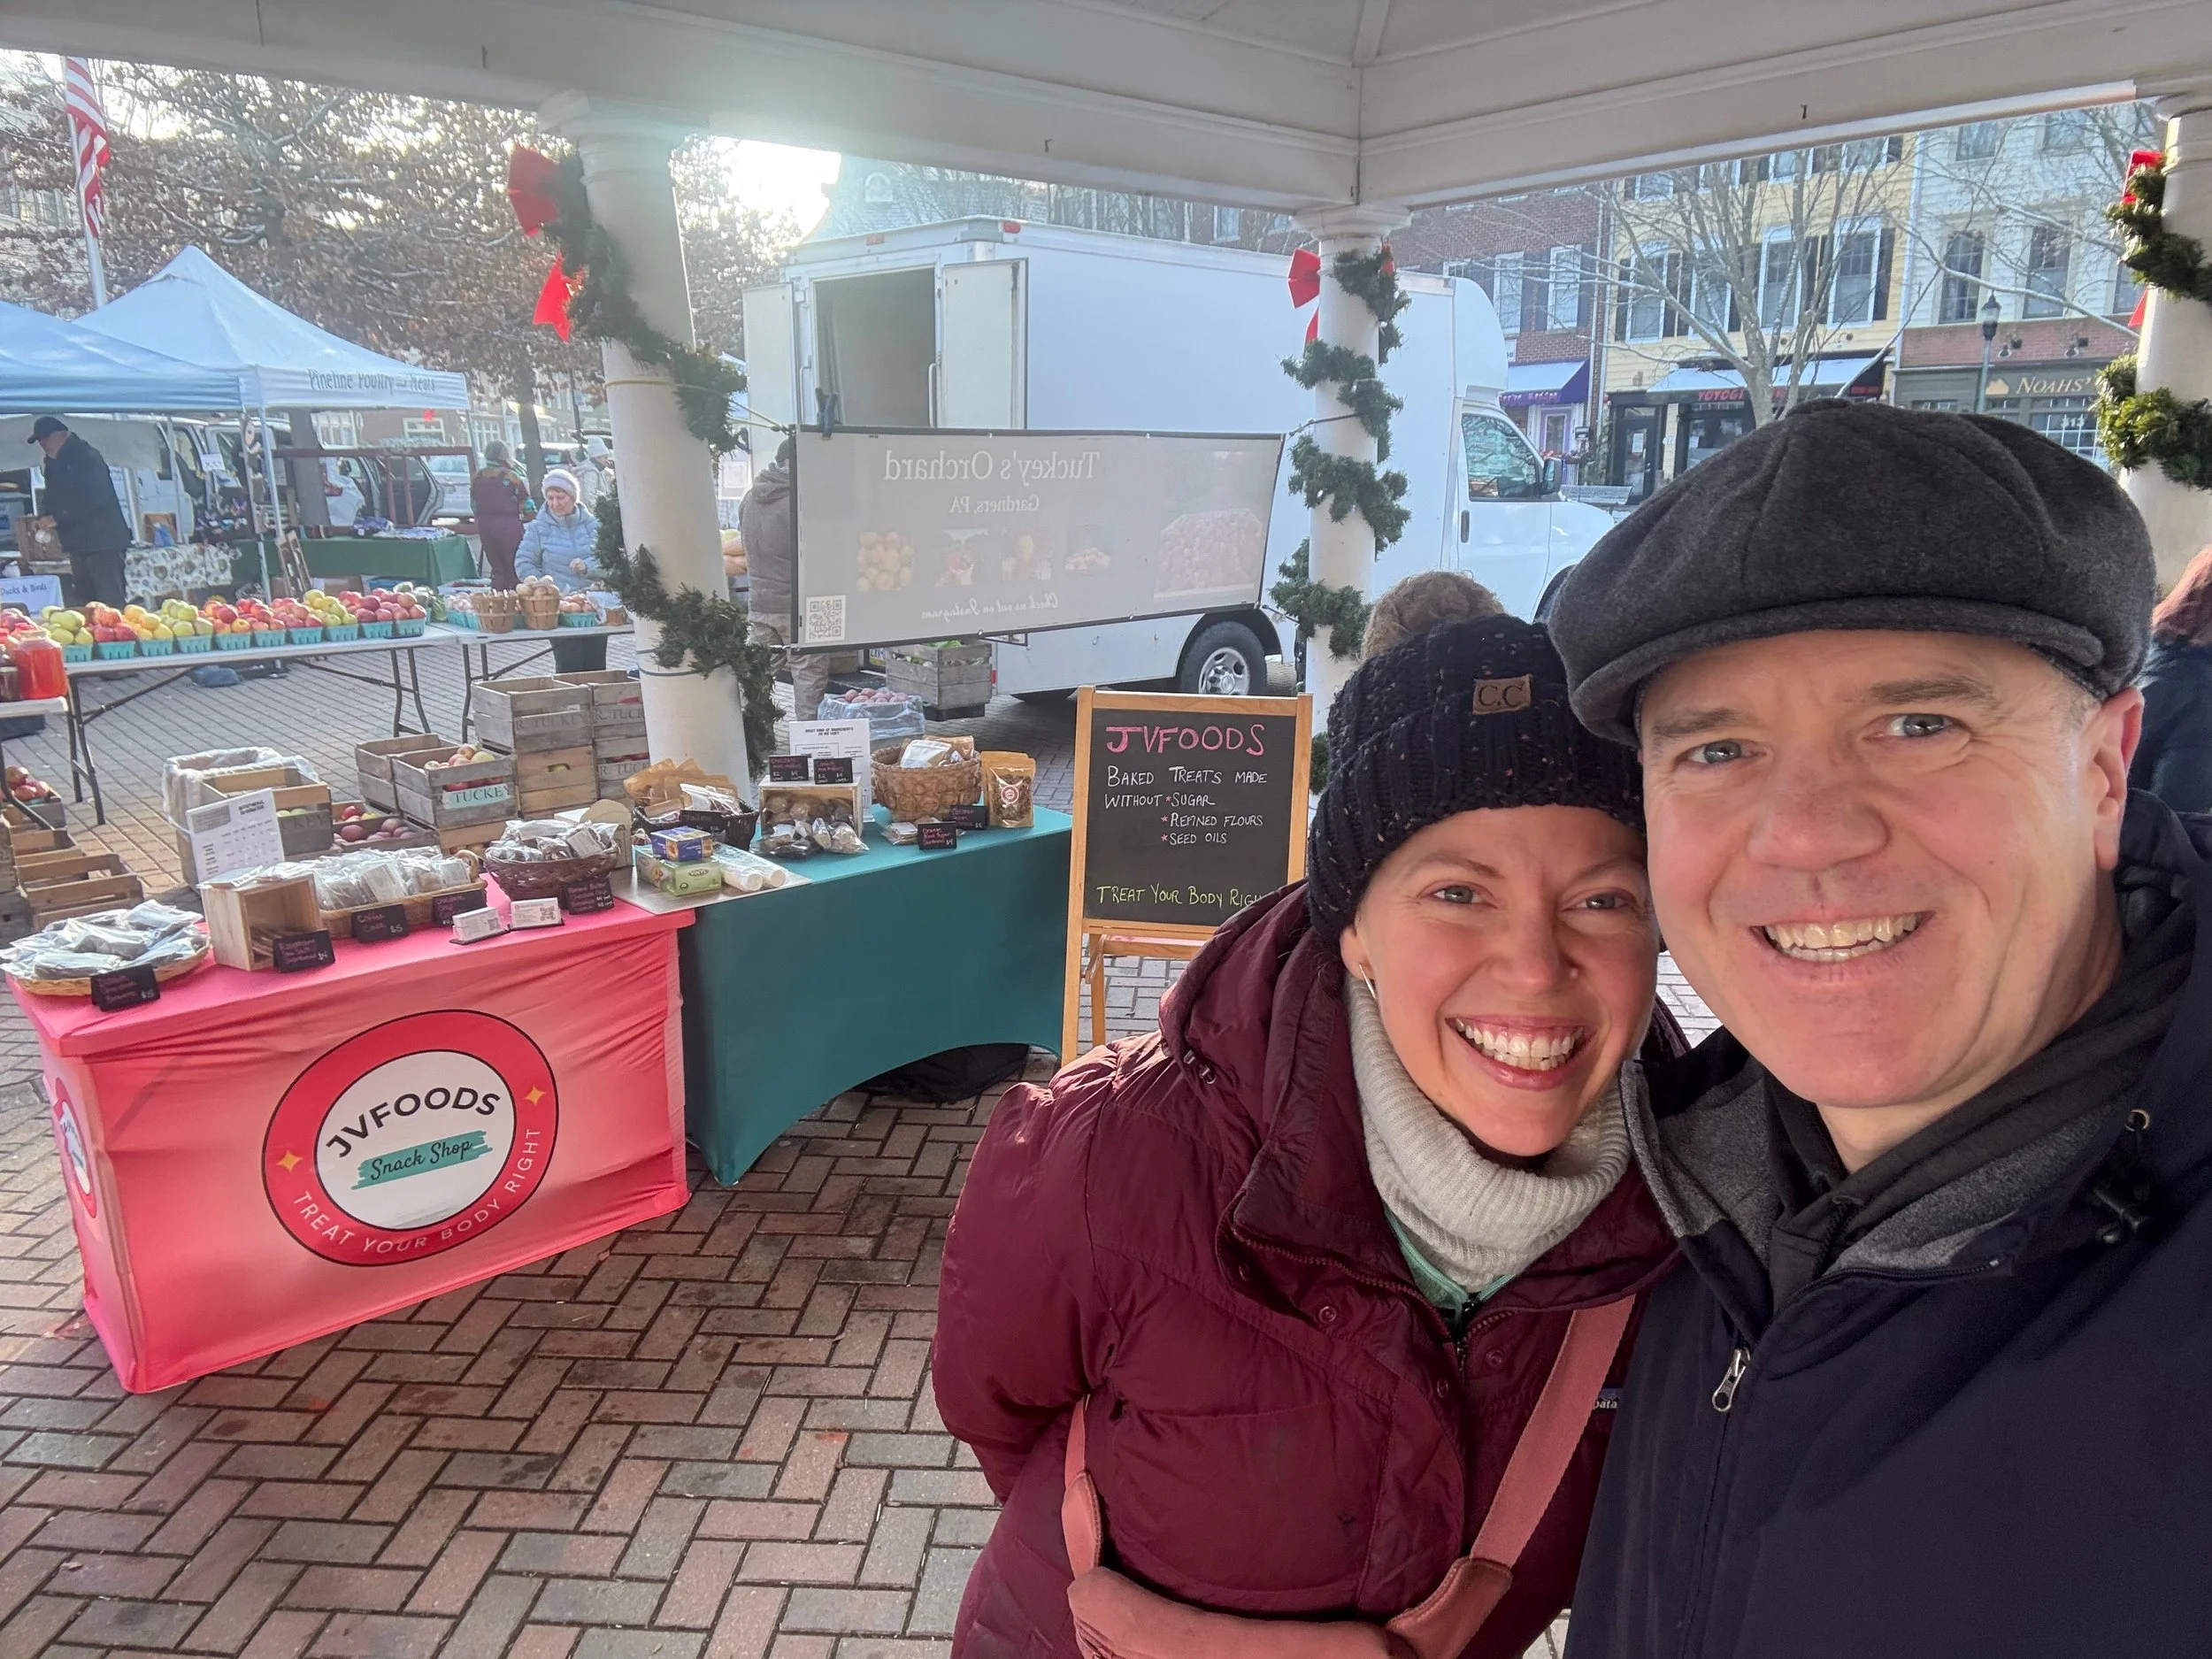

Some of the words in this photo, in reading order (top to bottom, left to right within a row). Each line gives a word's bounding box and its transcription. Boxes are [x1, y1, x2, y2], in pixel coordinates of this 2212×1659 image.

[357, 372, 394, 396] Poultry
[410, 373, 435, 392] Meats
[1698, 388, 1745, 402] YOYOGI
[612, 709, 644, 719] TUCK
[1106, 724, 1265, 756] JVFOODS
[616, 761, 650, 775] TUC
[1107, 765, 1155, 787] BAKED
[1169, 766, 1223, 785] TREATS
[1234, 771, 1268, 784] MADE
[1104, 794, 1164, 809] WITHOUT
[1171, 793, 1216, 807] SUGAR
[280, 815, 328, 831] CKEY
[1170, 812, 1217, 827] REFINED
[1224, 814, 1263, 826] FLOURS
[1170, 833, 1197, 845] SEED
[1205, 832, 1227, 844] OILS
[1096, 886, 1145, 905] TREAT
[1150, 883, 1182, 903] YOUR
[1189, 887, 1224, 908] BODY
[1230, 888, 1262, 907] RIG
[390, 923, 403, 933] $5
[326, 1087, 501, 1157] JVFOODS
[370, 1154, 426, 1181] Snack
[430, 1139, 473, 1164] Shop
[294, 1191, 354, 1246] TREAT
[362, 1235, 427, 1255] YOUR
[441, 1197, 502, 1240] BODY
[503, 1129, 541, 1194] RIGHT
